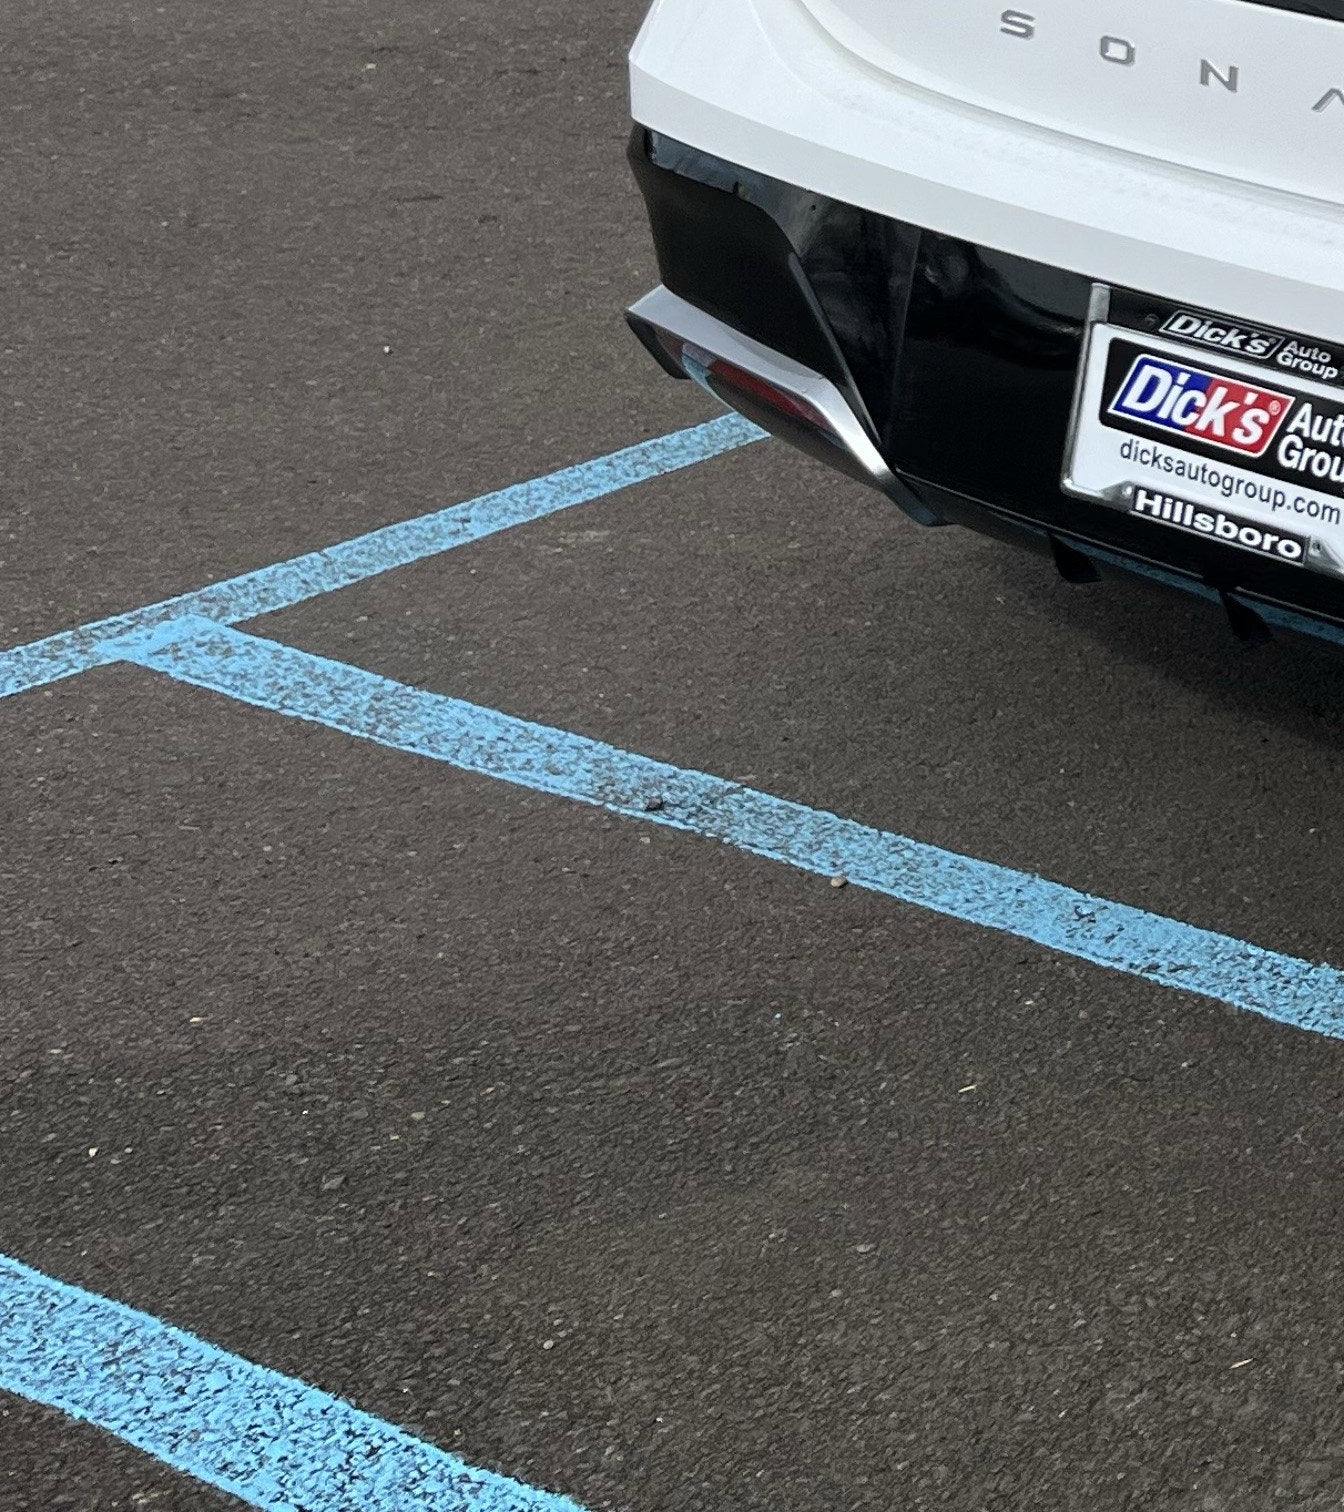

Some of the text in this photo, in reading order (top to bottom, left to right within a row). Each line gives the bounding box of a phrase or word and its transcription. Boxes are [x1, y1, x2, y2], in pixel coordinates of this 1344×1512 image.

[1168, 314, 1271, 356] Dick's
[1284, 340, 1332, 364] Auto
[1276, 350, 1339, 380] Group
[1121, 364, 1271, 445] Dick's
[1119, 438, 1341, 526] dicksautogroup.com
[1133, 488, 1302, 559] Hillsboro
